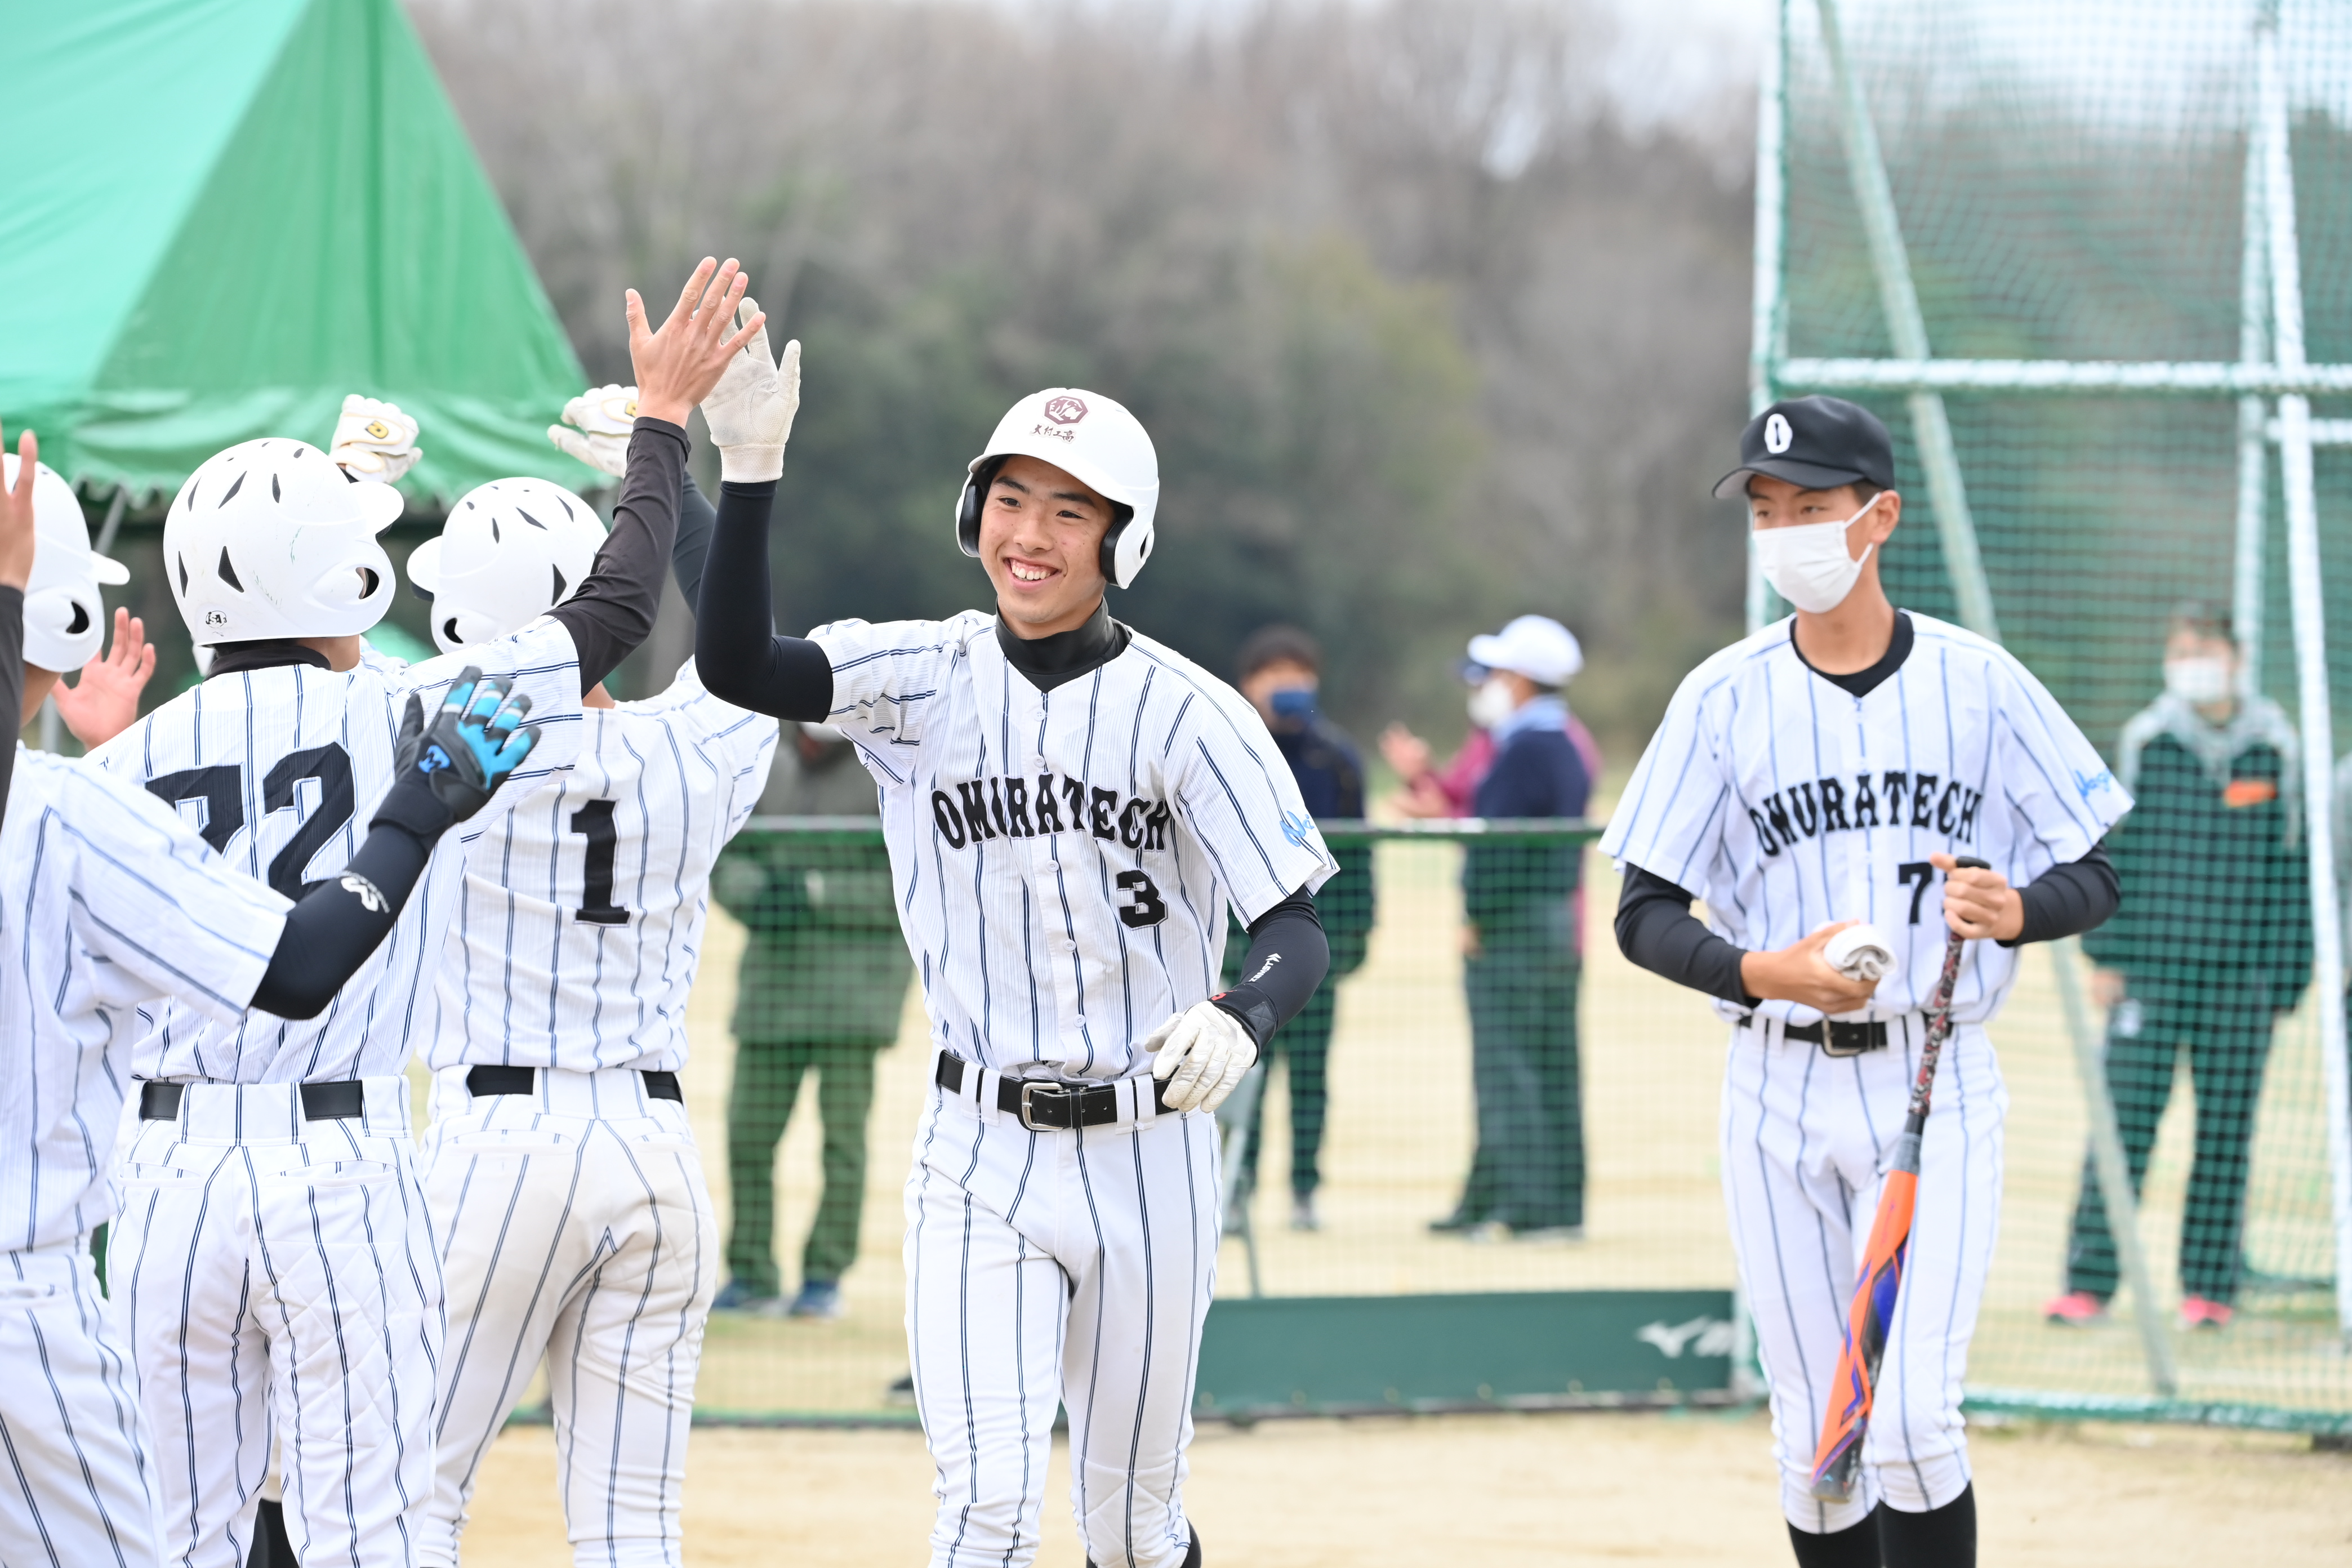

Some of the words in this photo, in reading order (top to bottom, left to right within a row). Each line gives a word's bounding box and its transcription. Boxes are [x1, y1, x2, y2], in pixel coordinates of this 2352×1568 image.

[1748, 770, 1983, 856] OMURATECH
[571, 799, 631, 925] 1
[1116, 870, 1167, 929] 3
